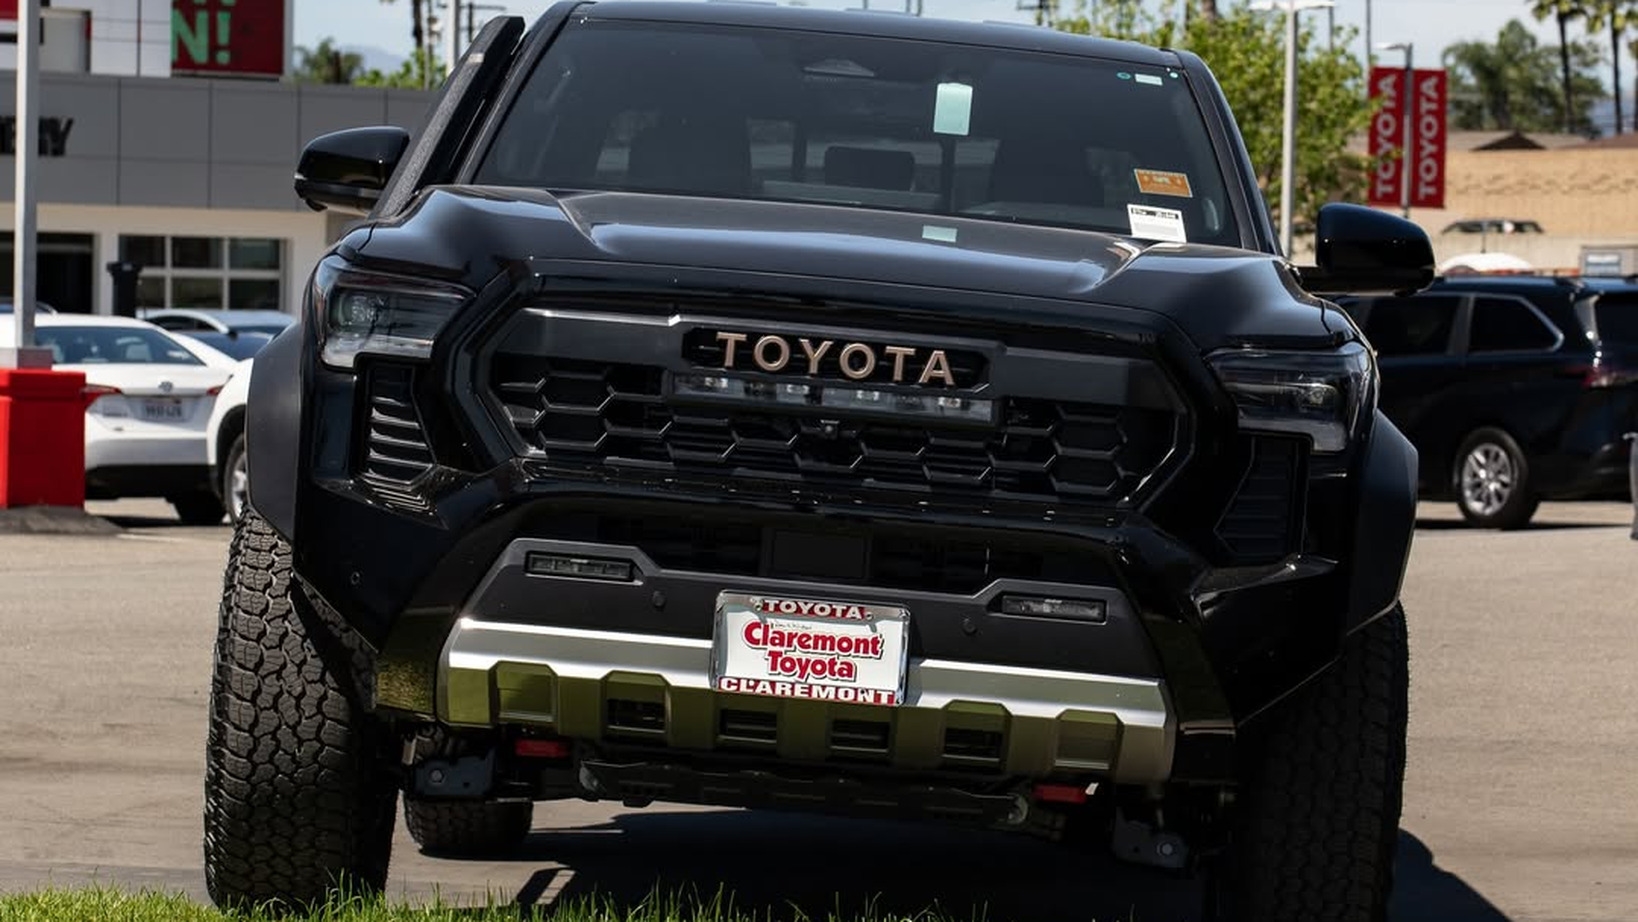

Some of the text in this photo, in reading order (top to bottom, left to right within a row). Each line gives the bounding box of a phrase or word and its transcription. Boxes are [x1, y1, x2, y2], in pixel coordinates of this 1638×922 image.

[1419, 76, 1439, 200] TOYOTA
[716, 331, 955, 386] TOYOTA
[764, 600, 862, 619] TOYOTA
[743, 620, 883, 659] Claremont
[766, 649, 857, 682] Toyota
[720, 677, 894, 705] CLAREMONT
